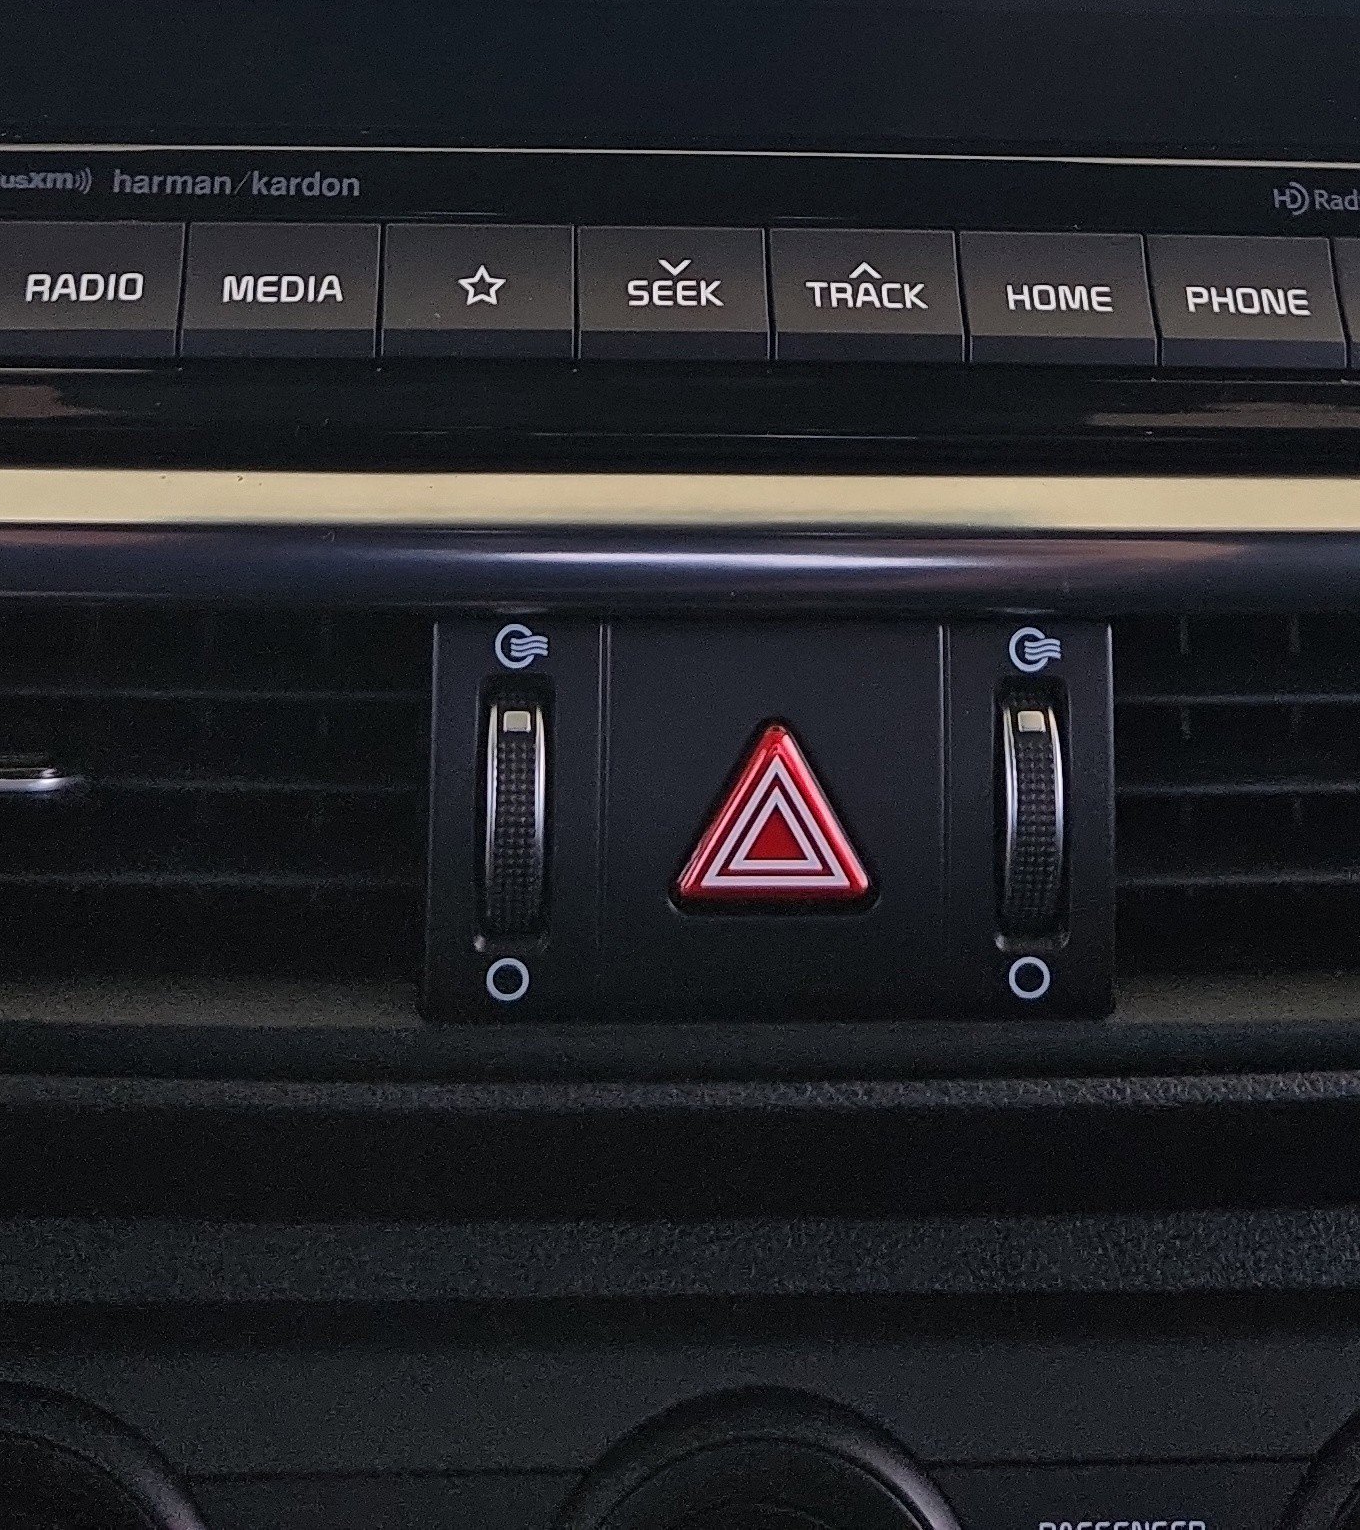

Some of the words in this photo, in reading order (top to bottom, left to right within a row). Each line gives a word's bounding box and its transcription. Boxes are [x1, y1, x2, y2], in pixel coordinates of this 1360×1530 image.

[25, 272, 144, 302] RADIO
[222, 275, 343, 303] MEDIA
[627, 280, 724, 307] SEEK
[805, 281, 928, 309] TRACK
[1006, 284, 1113, 312] HOME
[1185, 286, 1311, 316] PHONE
